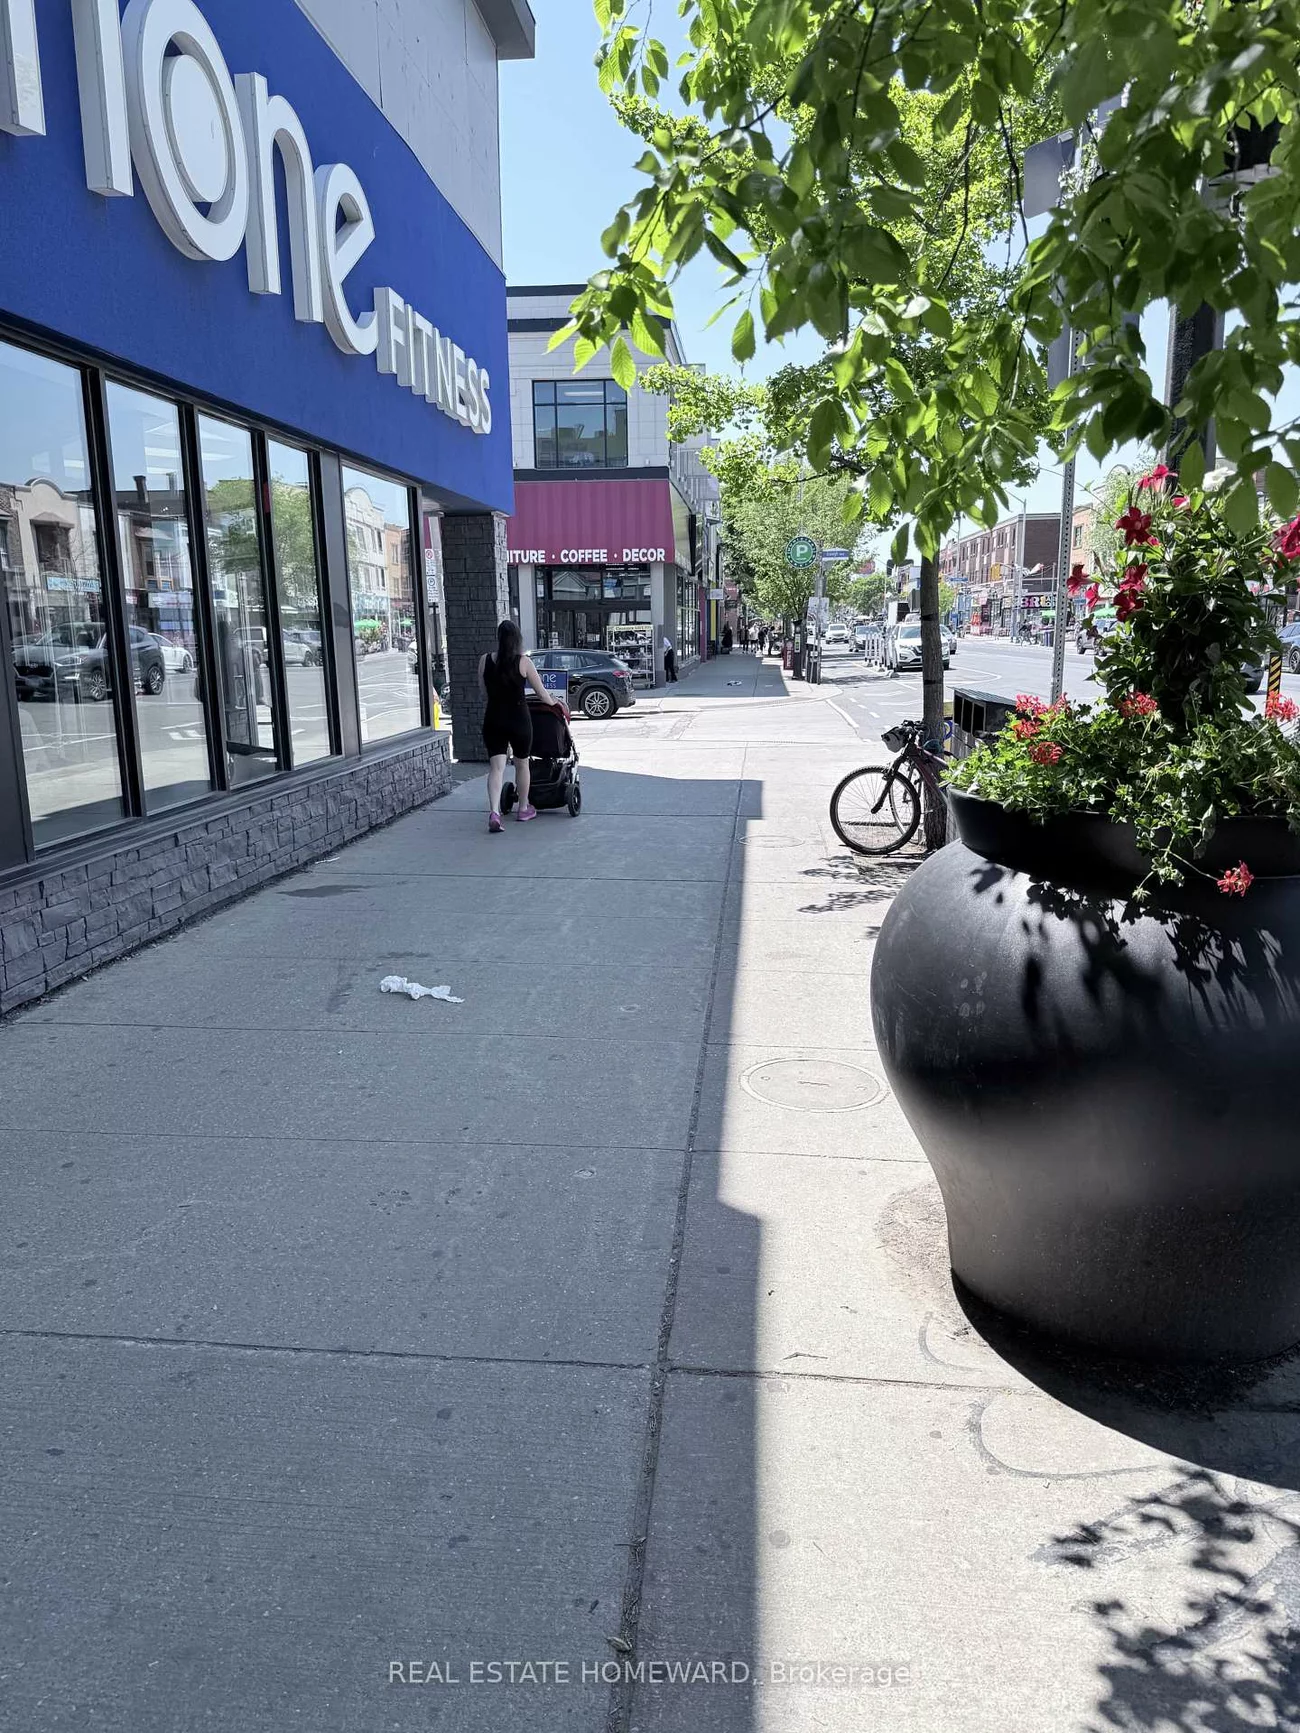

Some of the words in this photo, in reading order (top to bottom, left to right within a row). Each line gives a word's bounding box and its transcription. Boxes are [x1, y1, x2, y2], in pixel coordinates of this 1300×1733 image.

[374, 287, 491, 434] FITNESS
[560, 549, 608, 563] COFFEE
[623, 549, 665, 562] DECOR
[796, 545, 808, 557] P
[539, 673, 557, 683] ne
